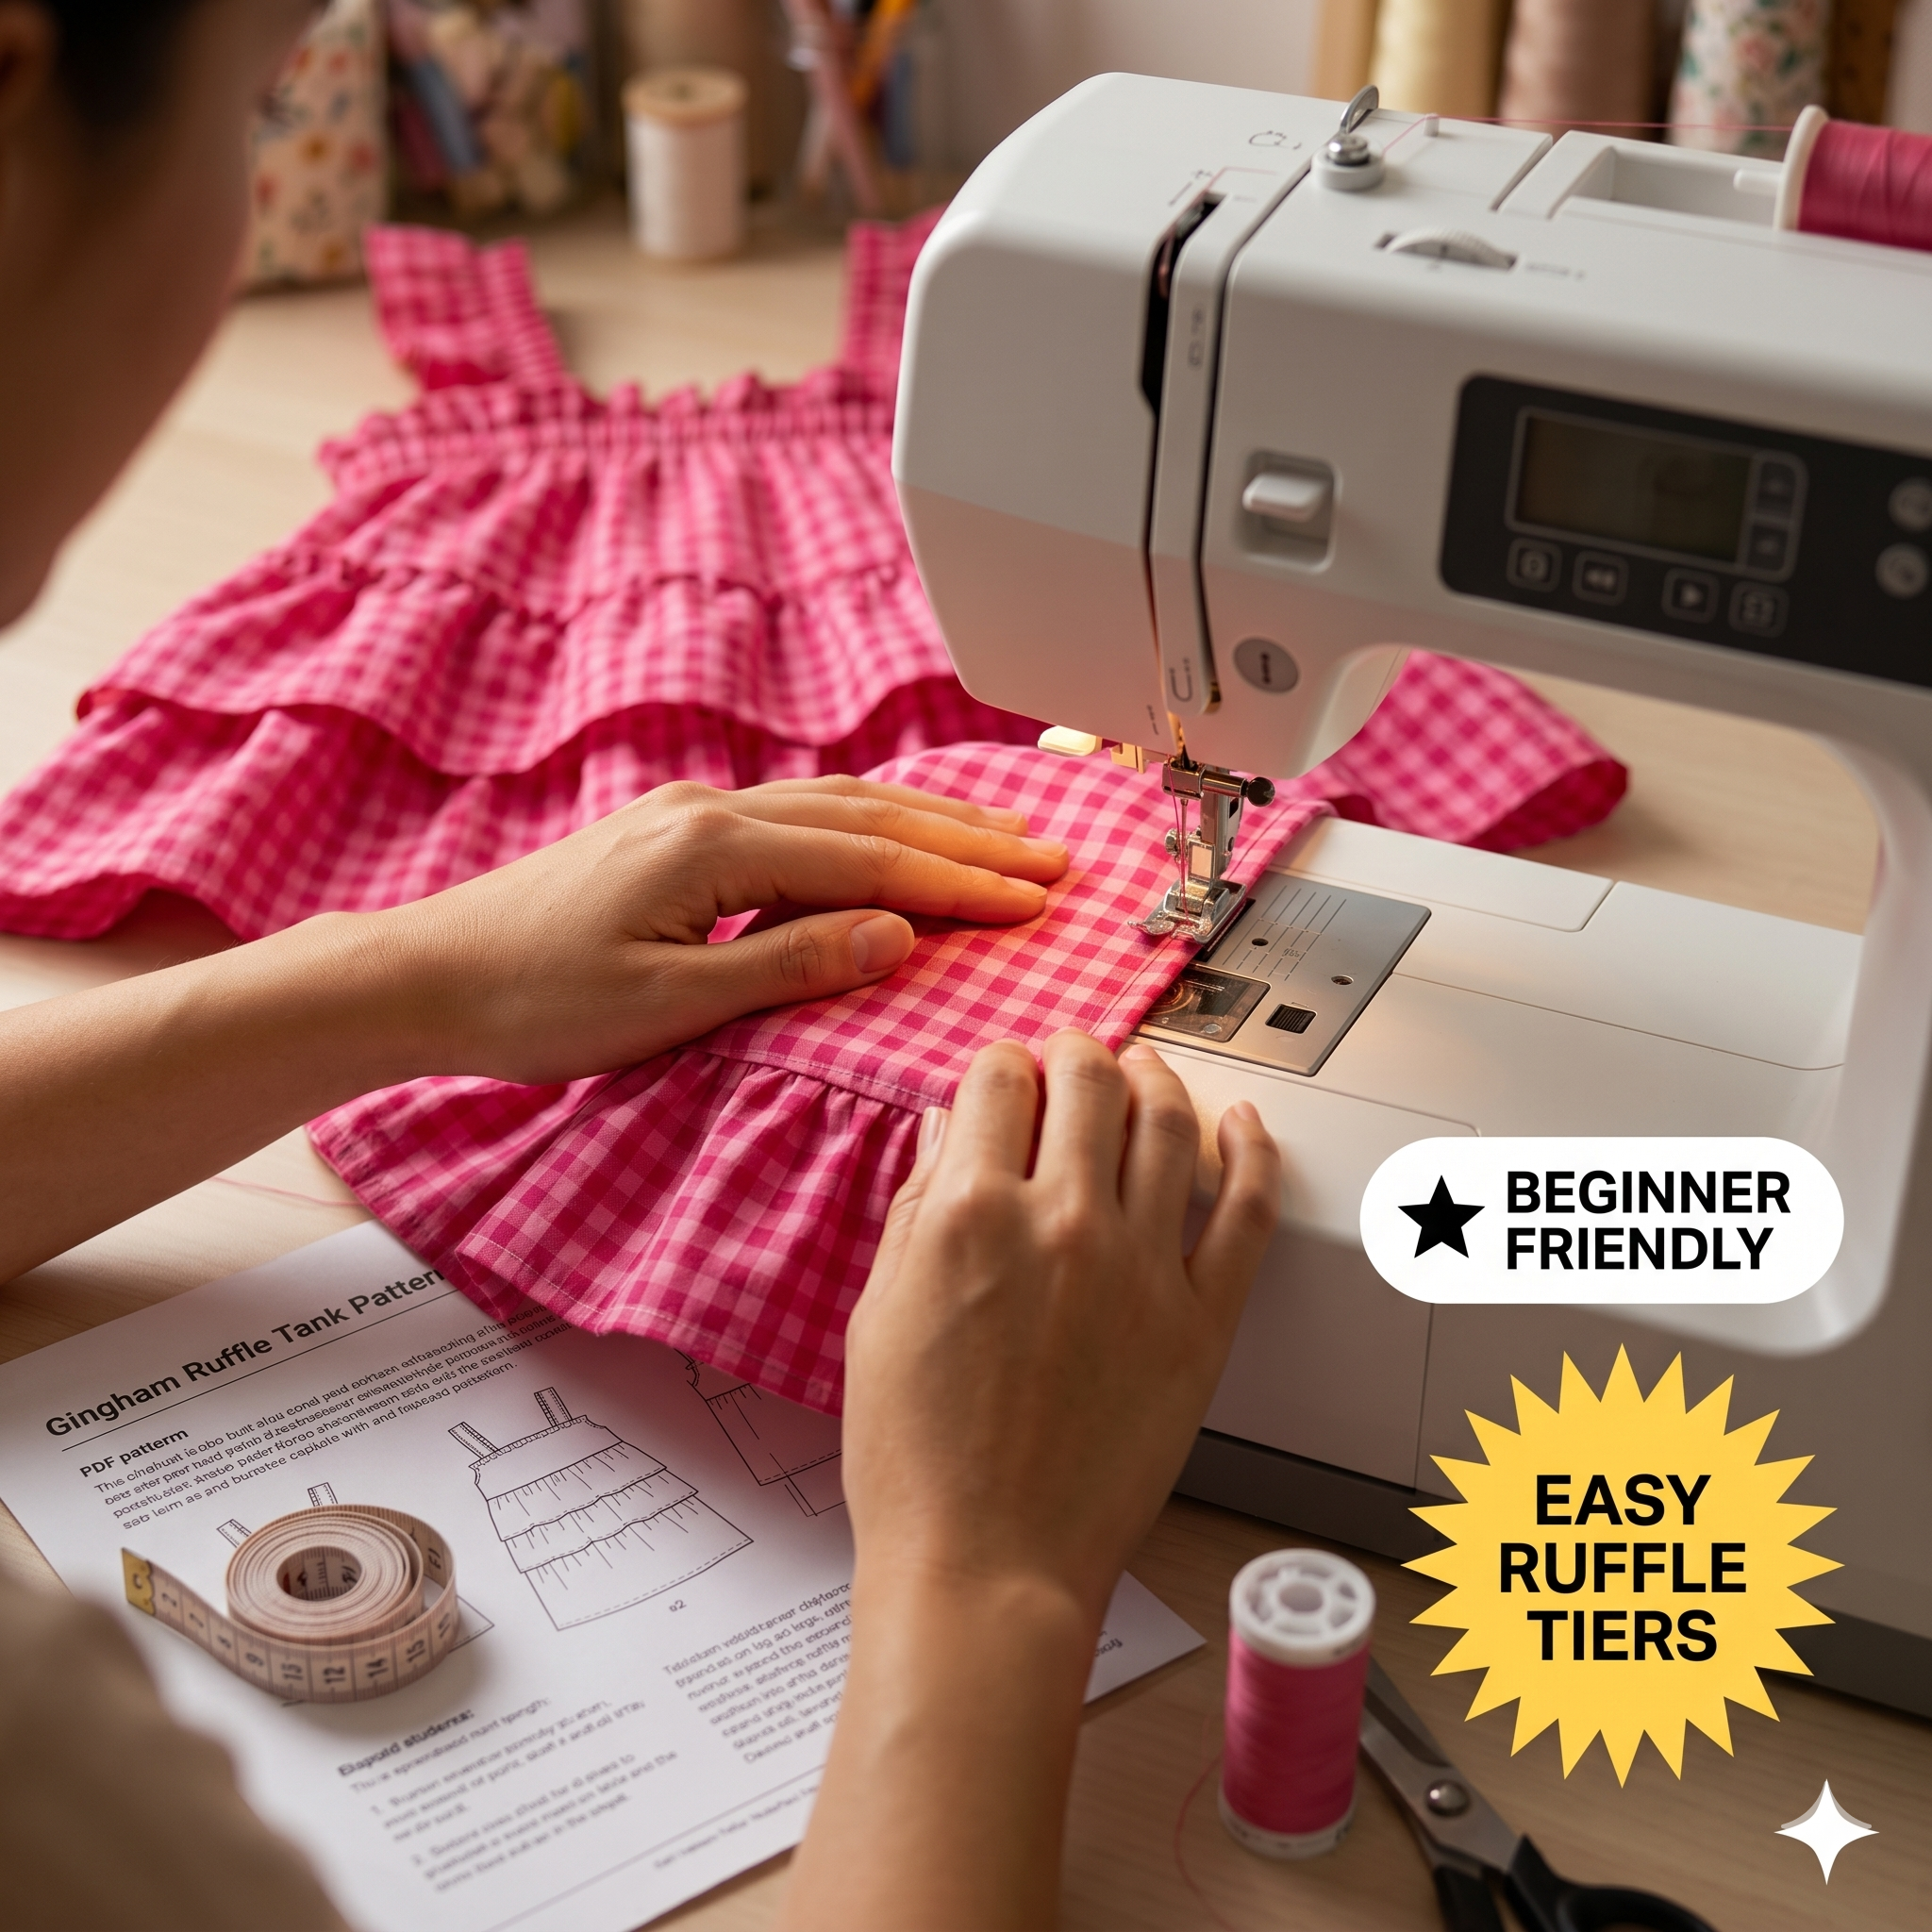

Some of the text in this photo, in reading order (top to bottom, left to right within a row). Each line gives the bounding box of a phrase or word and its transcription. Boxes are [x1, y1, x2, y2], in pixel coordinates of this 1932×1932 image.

[45, 1376, 181, 1436] Gingham
[182, 1340, 273, 1382] Ruffle
[271, 1307, 350, 1343] Tank
[79, 1457, 116, 1477] PDF
